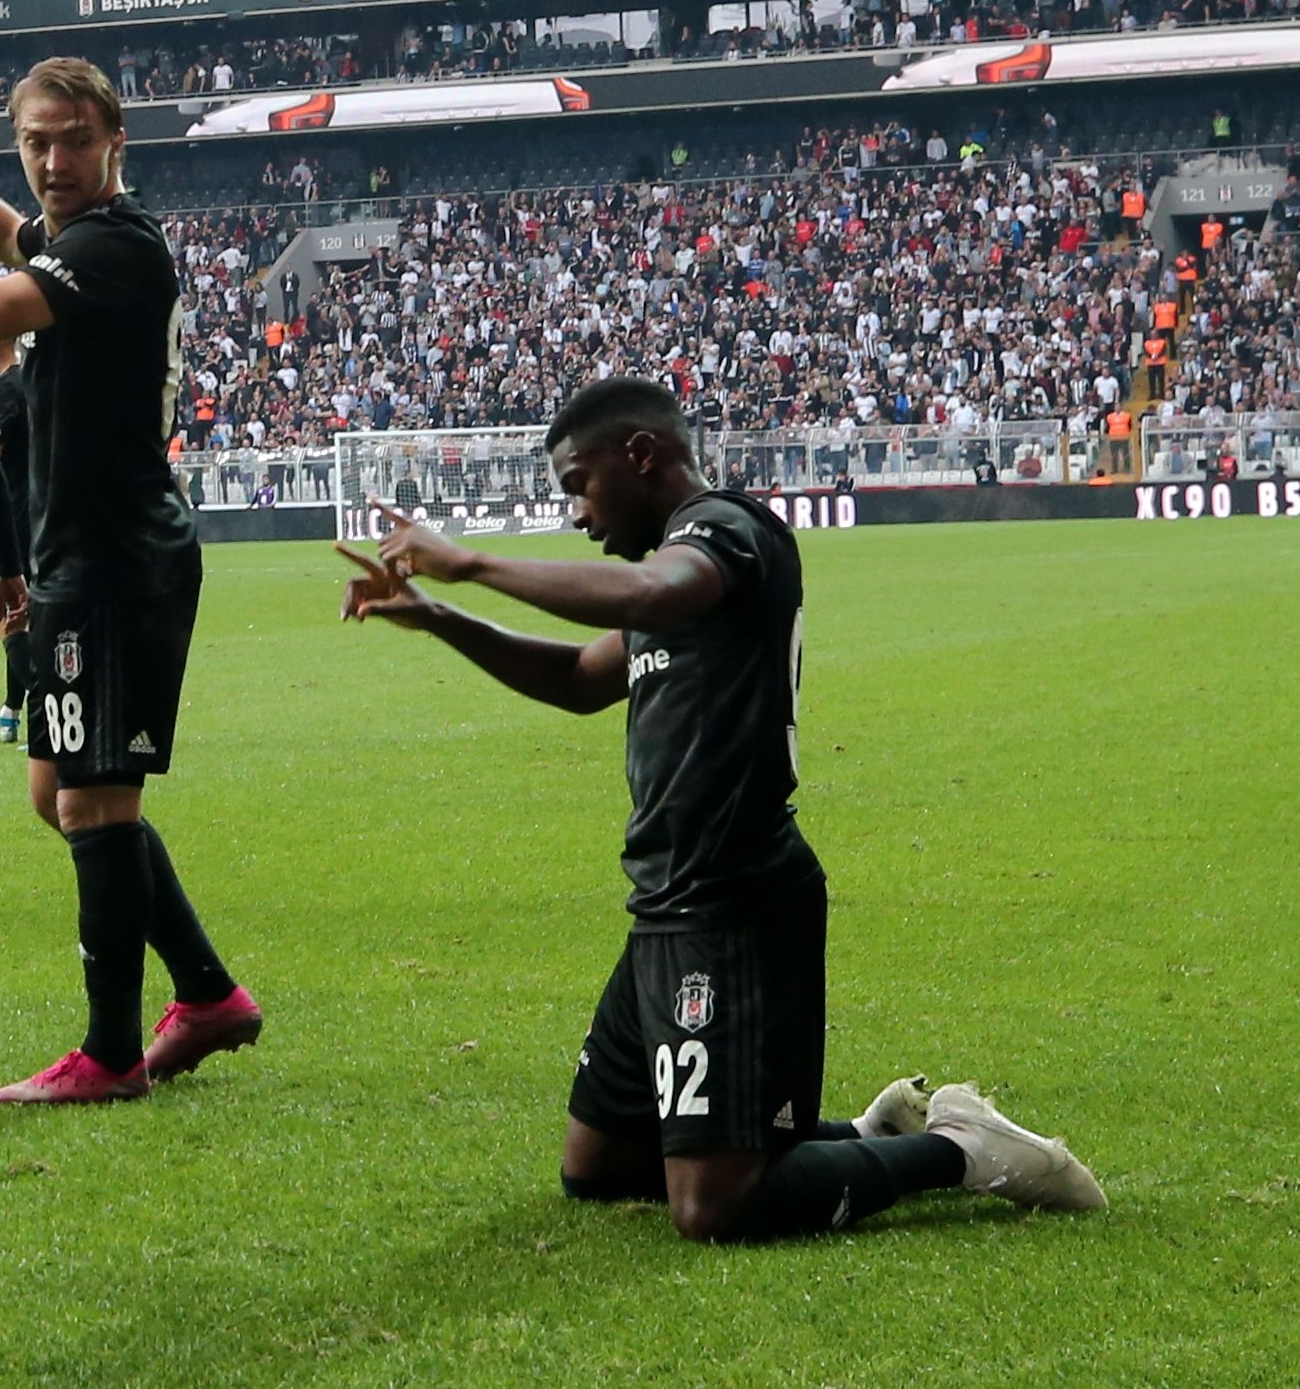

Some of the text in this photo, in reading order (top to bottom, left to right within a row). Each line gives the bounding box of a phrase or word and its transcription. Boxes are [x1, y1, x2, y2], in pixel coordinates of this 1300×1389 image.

[1181, 188, 1206, 202] 121
[1247, 184, 1273, 198] 122
[320, 237, 342, 250] 120
[1136, 481, 1300, 519] XC90 B5
[465, 516, 507, 530] beko
[522, 515, 565, 529] beko
[45, 692, 85, 754] 88
[654, 1040, 709, 1119] 92
